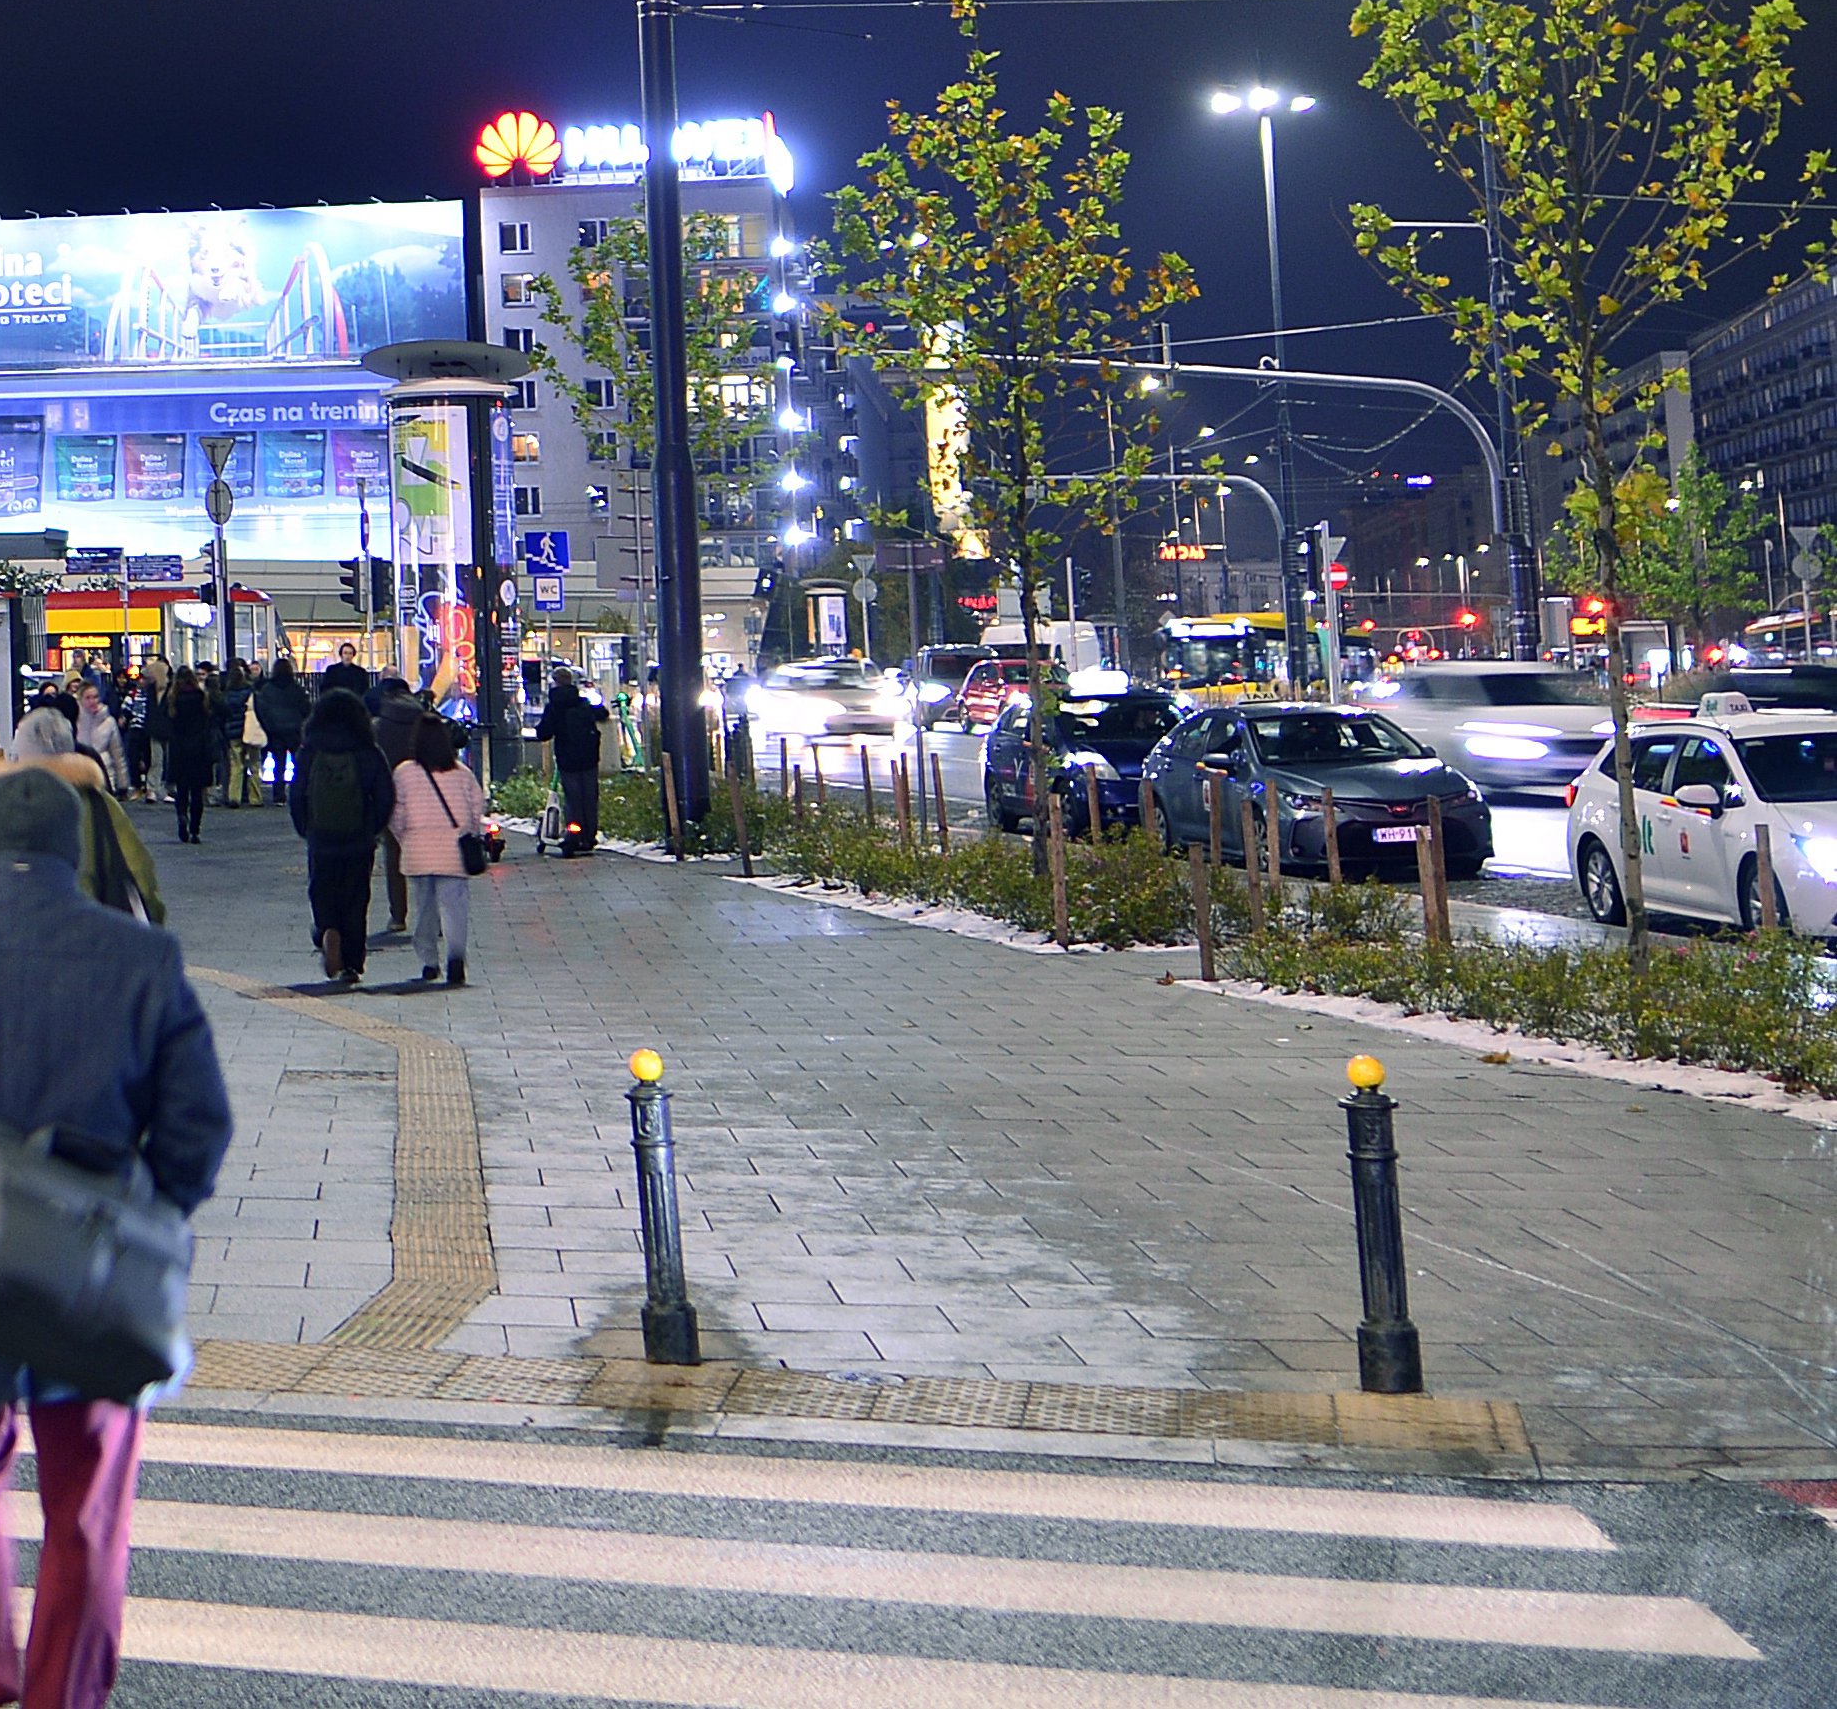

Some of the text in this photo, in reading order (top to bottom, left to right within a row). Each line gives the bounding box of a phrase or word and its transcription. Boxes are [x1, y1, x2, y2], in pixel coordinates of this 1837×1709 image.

[13, 314, 67, 324] TREATS
[209, 401, 268, 426] Czas
[273, 406, 304, 421] na
[540, 586, 558, 594] WC
[1380, 830, 1395, 839] WH
